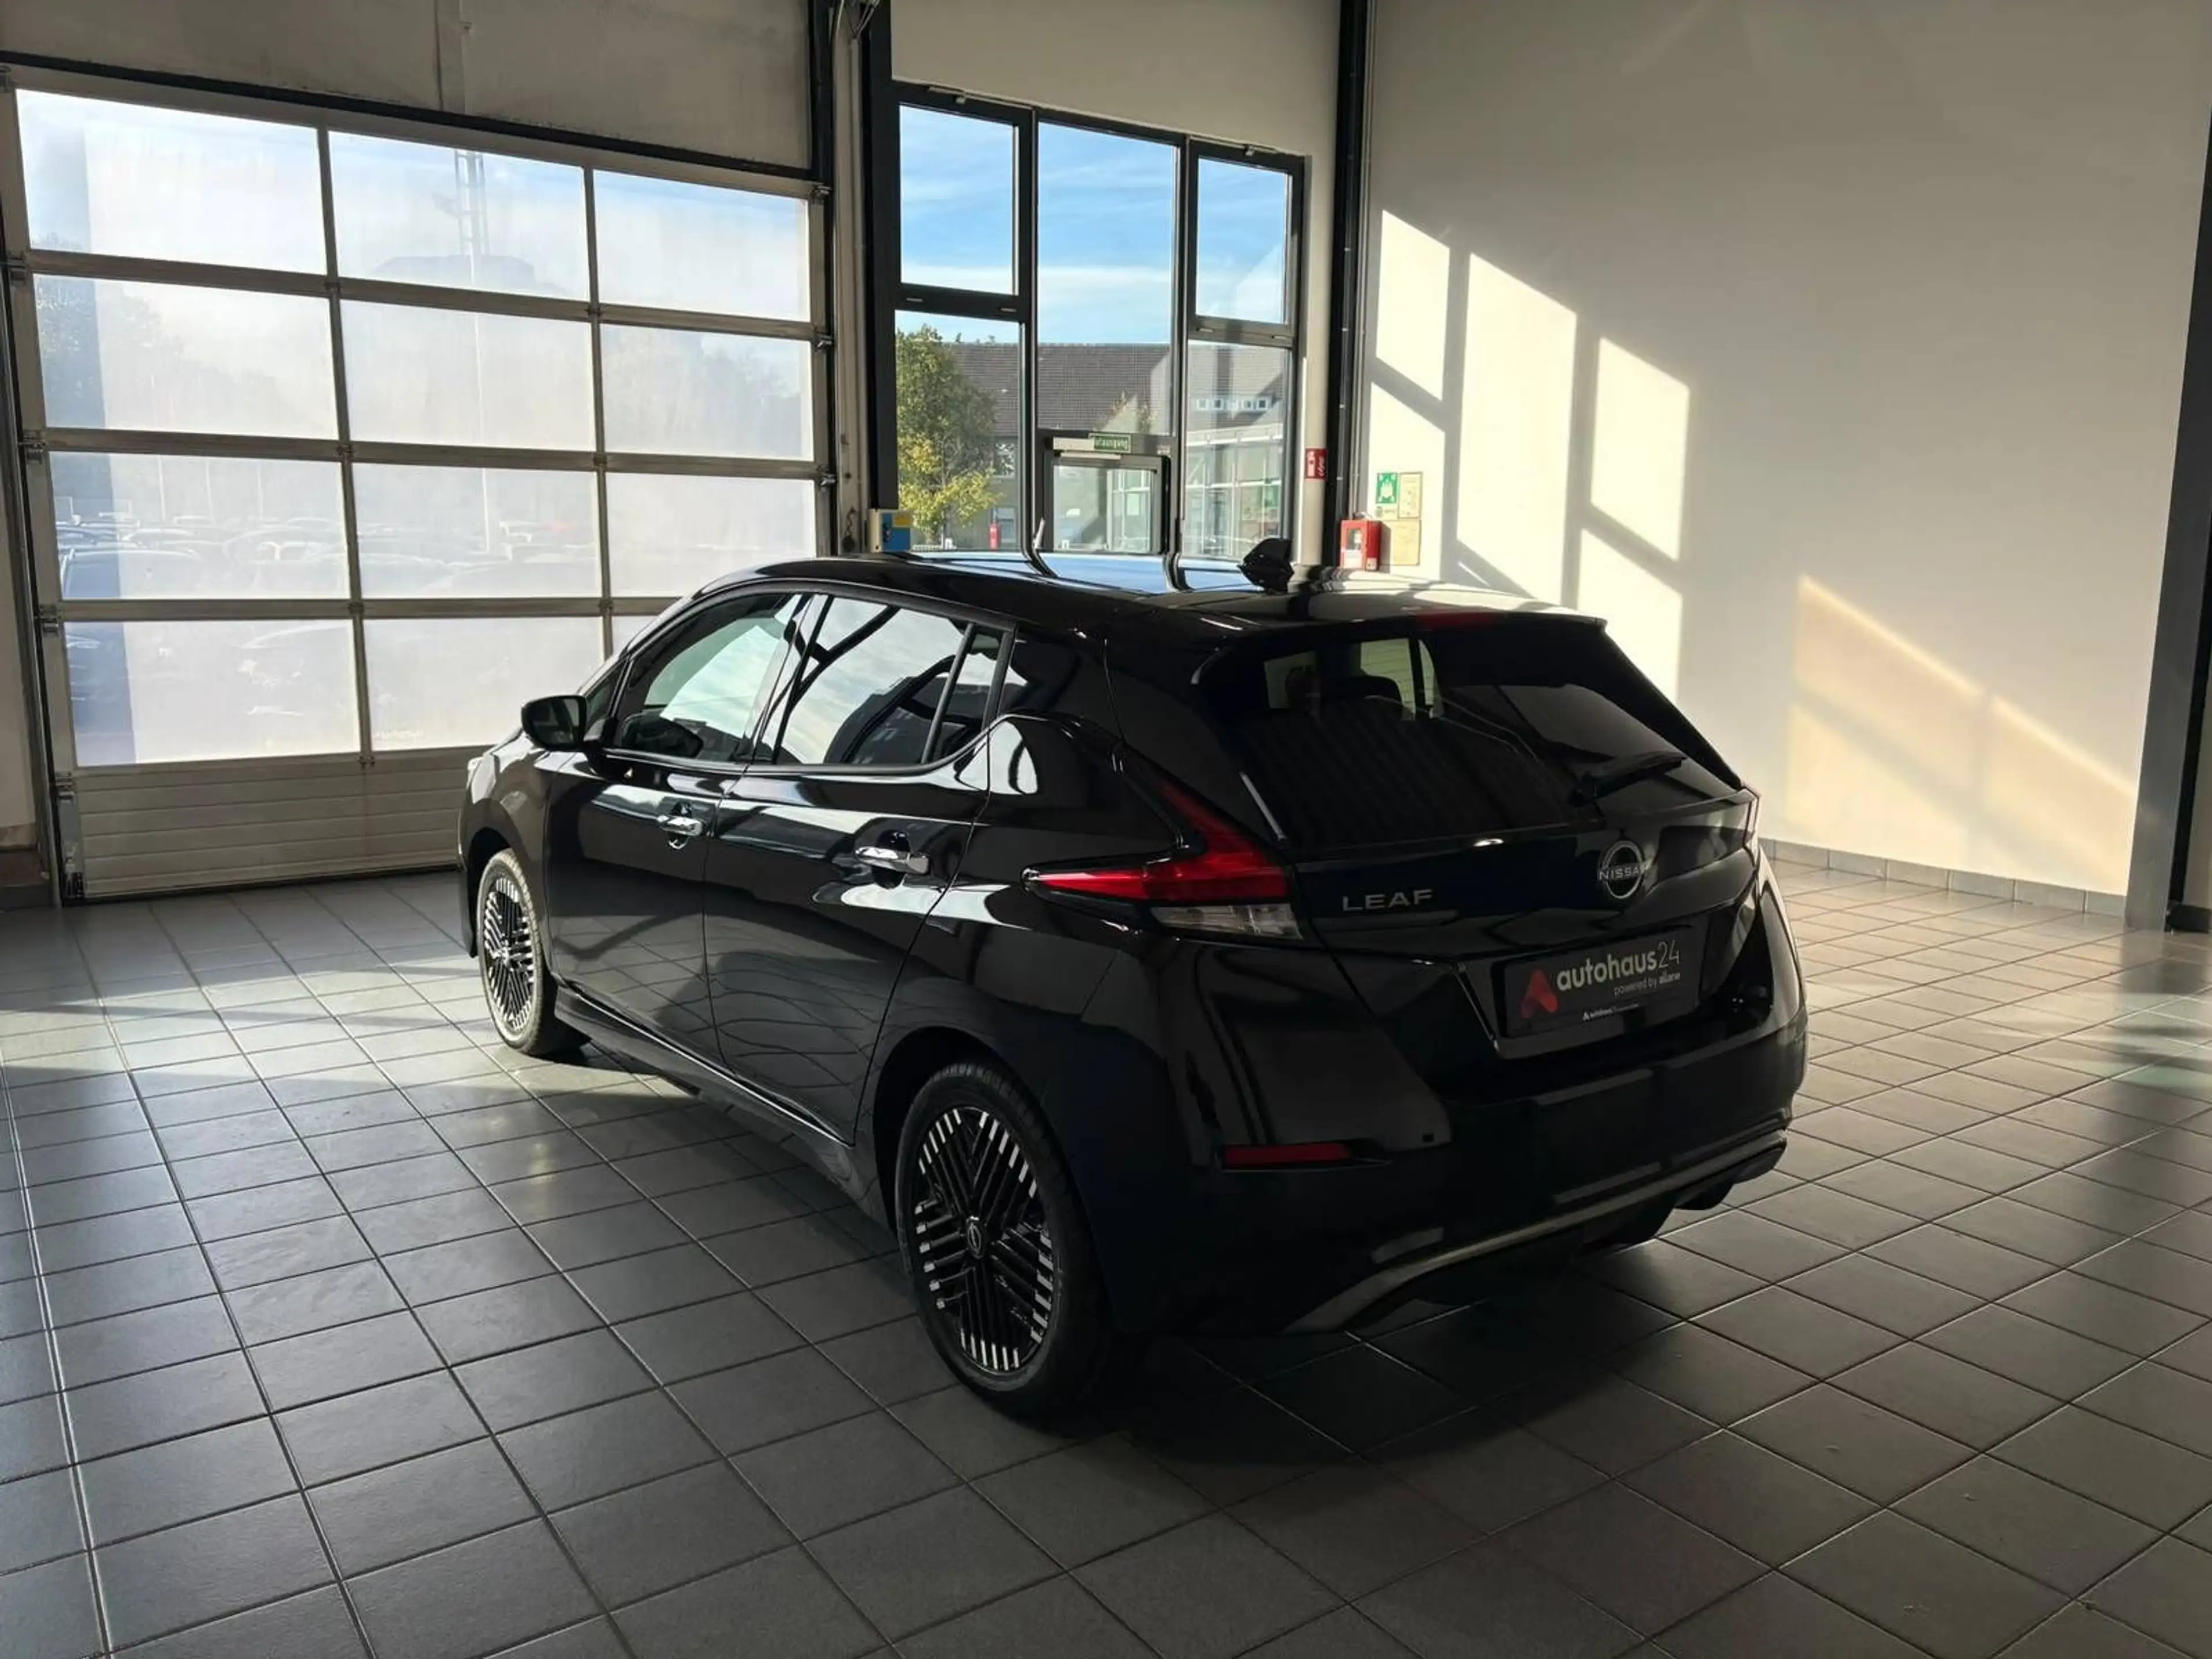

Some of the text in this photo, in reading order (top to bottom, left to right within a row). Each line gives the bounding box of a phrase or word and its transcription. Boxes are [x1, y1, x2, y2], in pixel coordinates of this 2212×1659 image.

[1342, 888, 1433, 911] LEAF
[1556, 940, 1680, 992] autohaus24
[1615, 979, 1647, 999] powered
[1647, 977, 1657, 992] by
